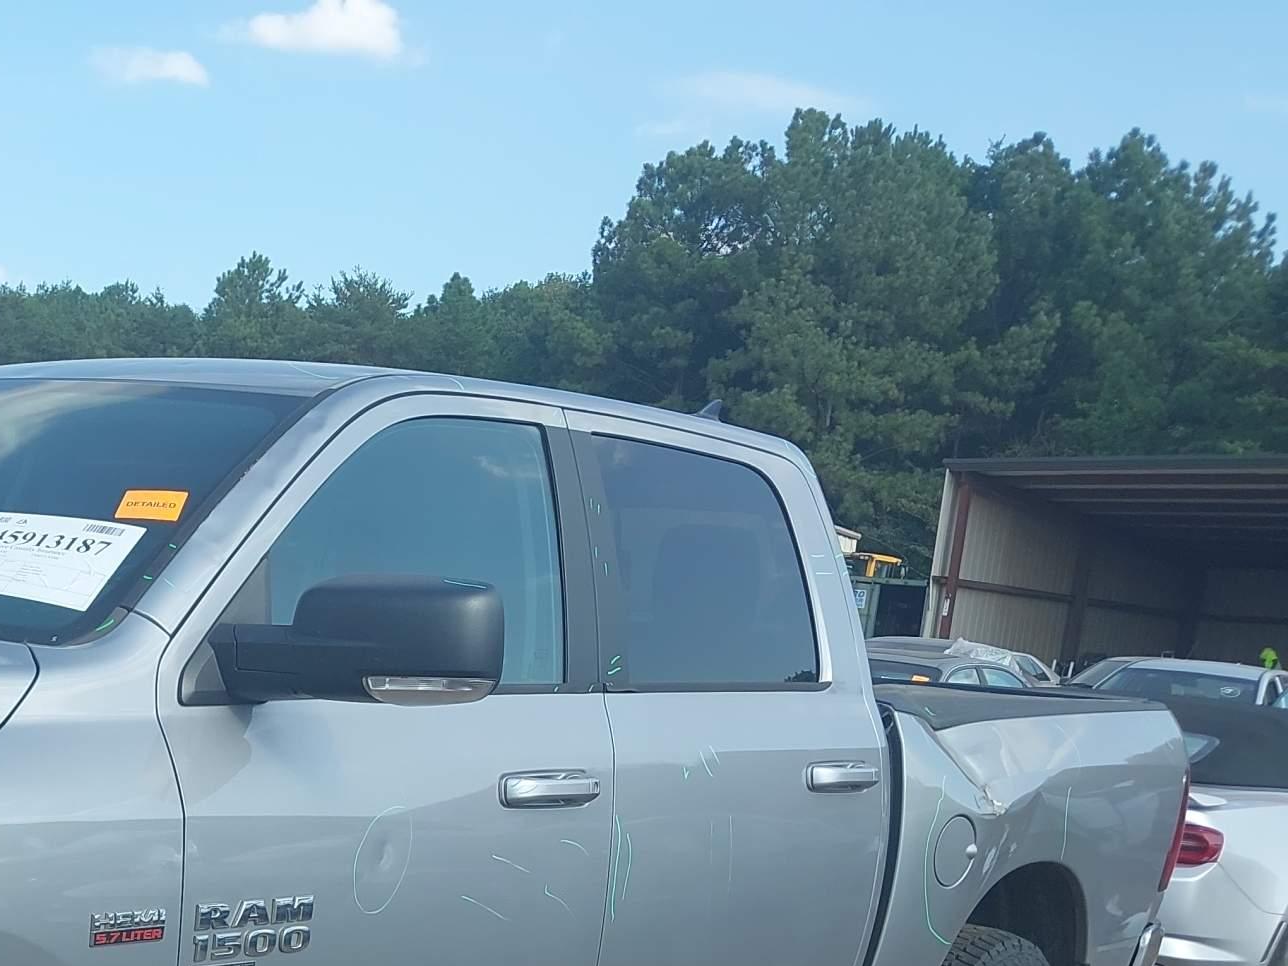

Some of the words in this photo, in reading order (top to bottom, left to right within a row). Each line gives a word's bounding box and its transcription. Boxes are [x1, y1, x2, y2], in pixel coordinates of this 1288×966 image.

[126, 501, 177, 509] DETAILED
[92, 908, 166, 931] HEMI
[194, 895, 314, 931] RAM
[95, 932, 119, 945] 5.7
[122, 929, 163, 943] LITER
[193, 926, 312, 962] 1500
